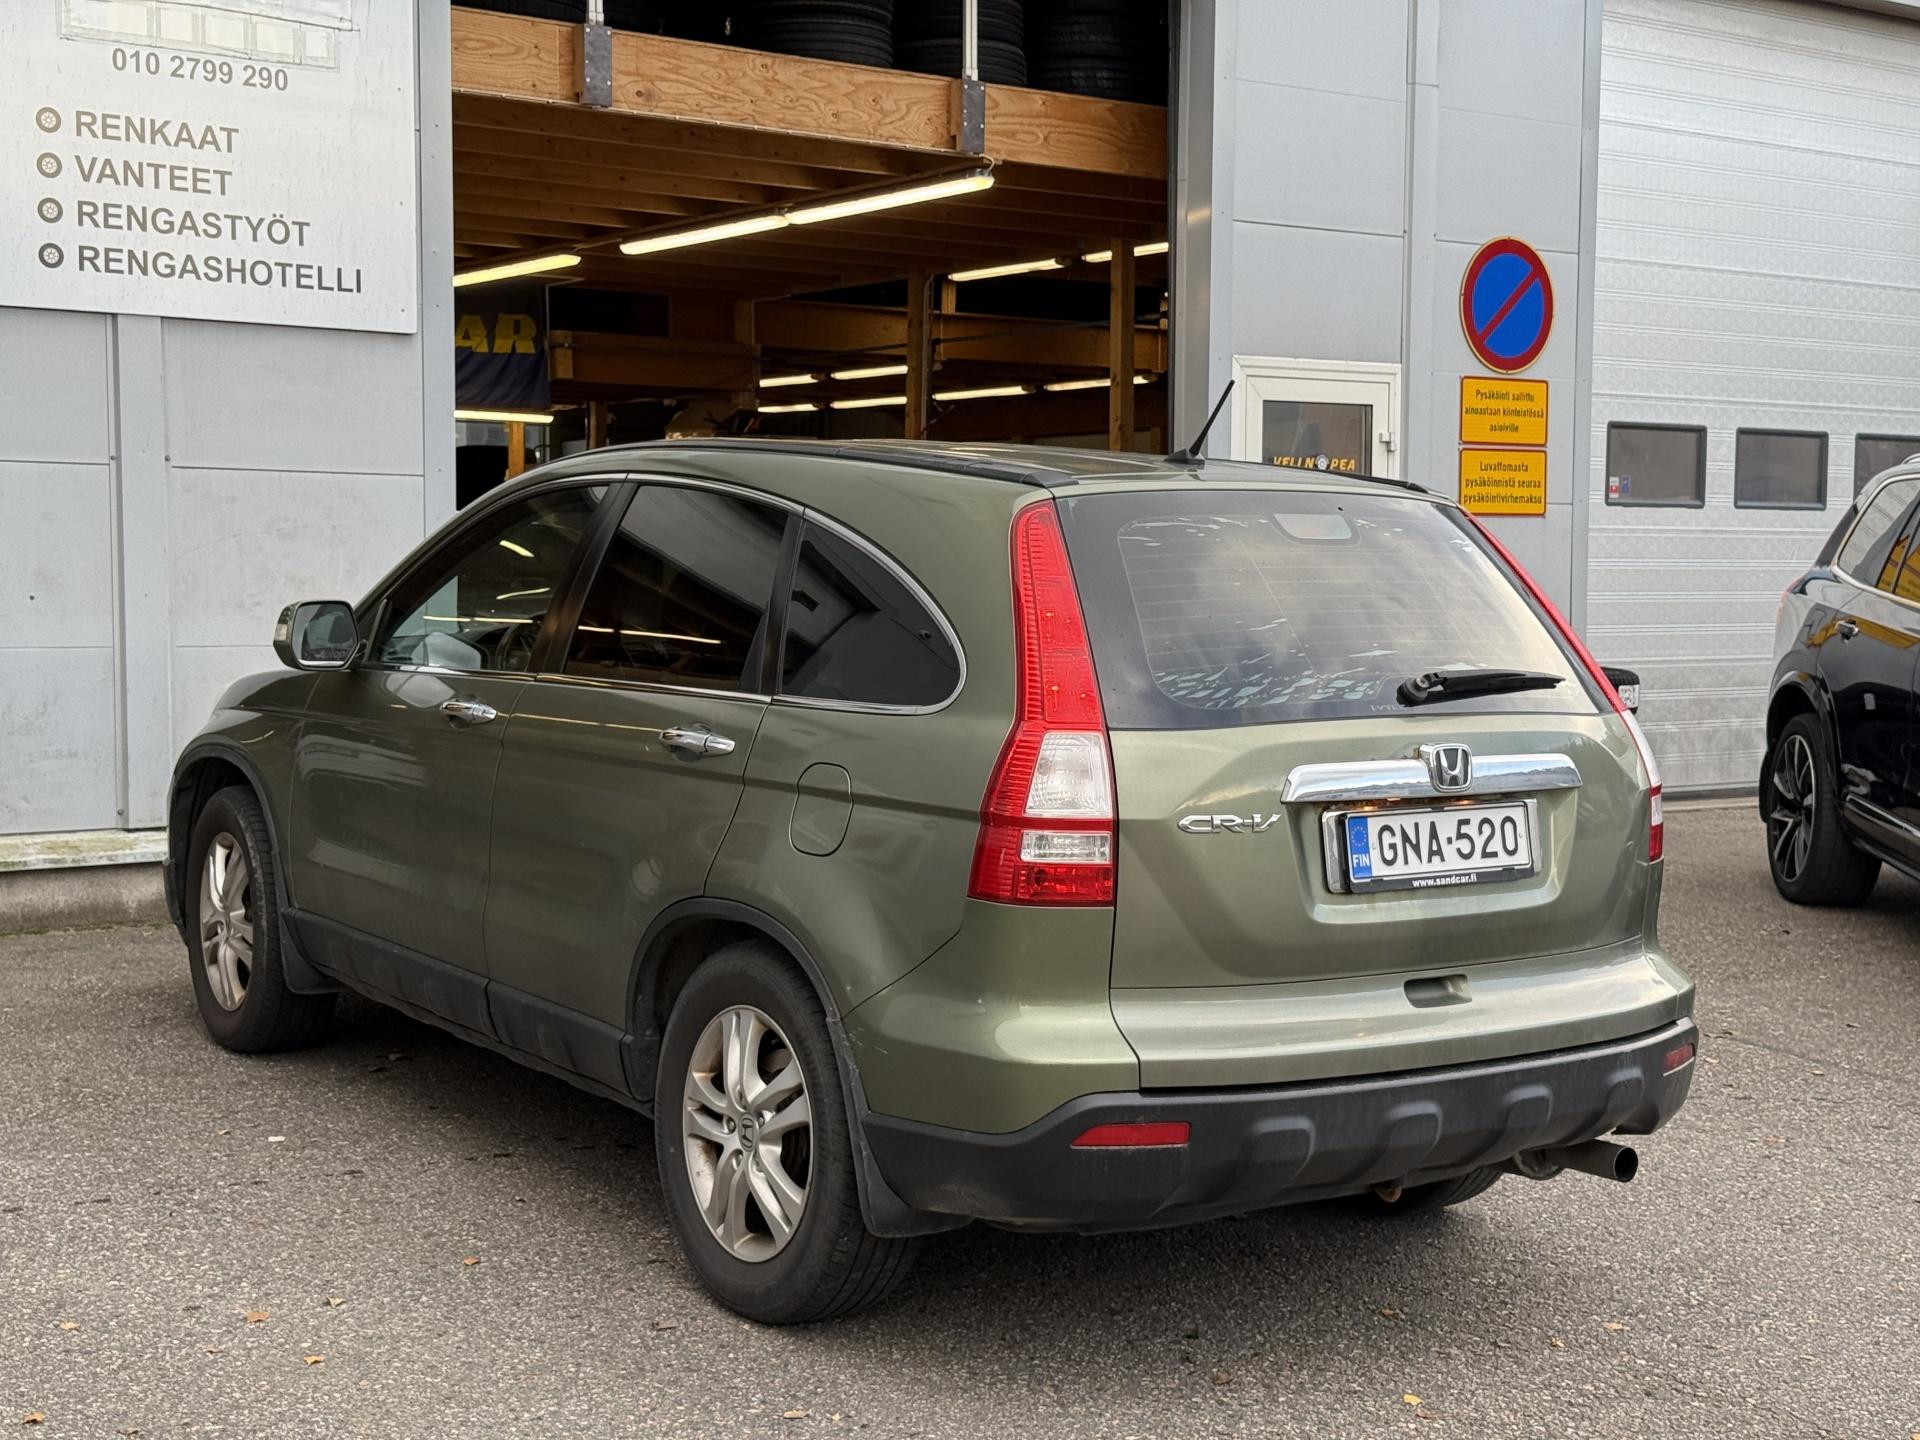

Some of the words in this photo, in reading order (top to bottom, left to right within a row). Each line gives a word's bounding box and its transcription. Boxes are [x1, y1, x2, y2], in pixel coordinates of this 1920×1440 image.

[112, 48, 160, 75] 010
[169, 55, 234, 84] 2799
[242, 65, 289, 91] 290
[74, 110, 239, 154] RENKAAT
[74, 155, 233, 196] VANTEET
[77, 200, 311, 247] RENGASTYÖT
[78, 245, 362, 294] RENGASHOTELLI
[1475, 389, 1510, 401] Pysäköinti
[1512, 391, 1535, 401] sallittu
[1464, 405, 1501, 416] ainoastaan
[1502, 407, 1544, 418] kiinteistössä
[1489, 422, 1519, 433] asioiville
[1480, 461, 1529, 472] Luvattomasta
[1465, 477, 1516, 489] pysäköinnistä
[1517, 479, 1541, 489] seuraa
[1463, 493, 1542, 505] pysäköintivirhemaksu
[1176, 813, 1282, 835] CR-V
[1377, 816, 1519, 866] GNA-520
[1352, 853, 1370, 869] FIN
[1412, 873, 1477, 889] www.sandcar.fi
